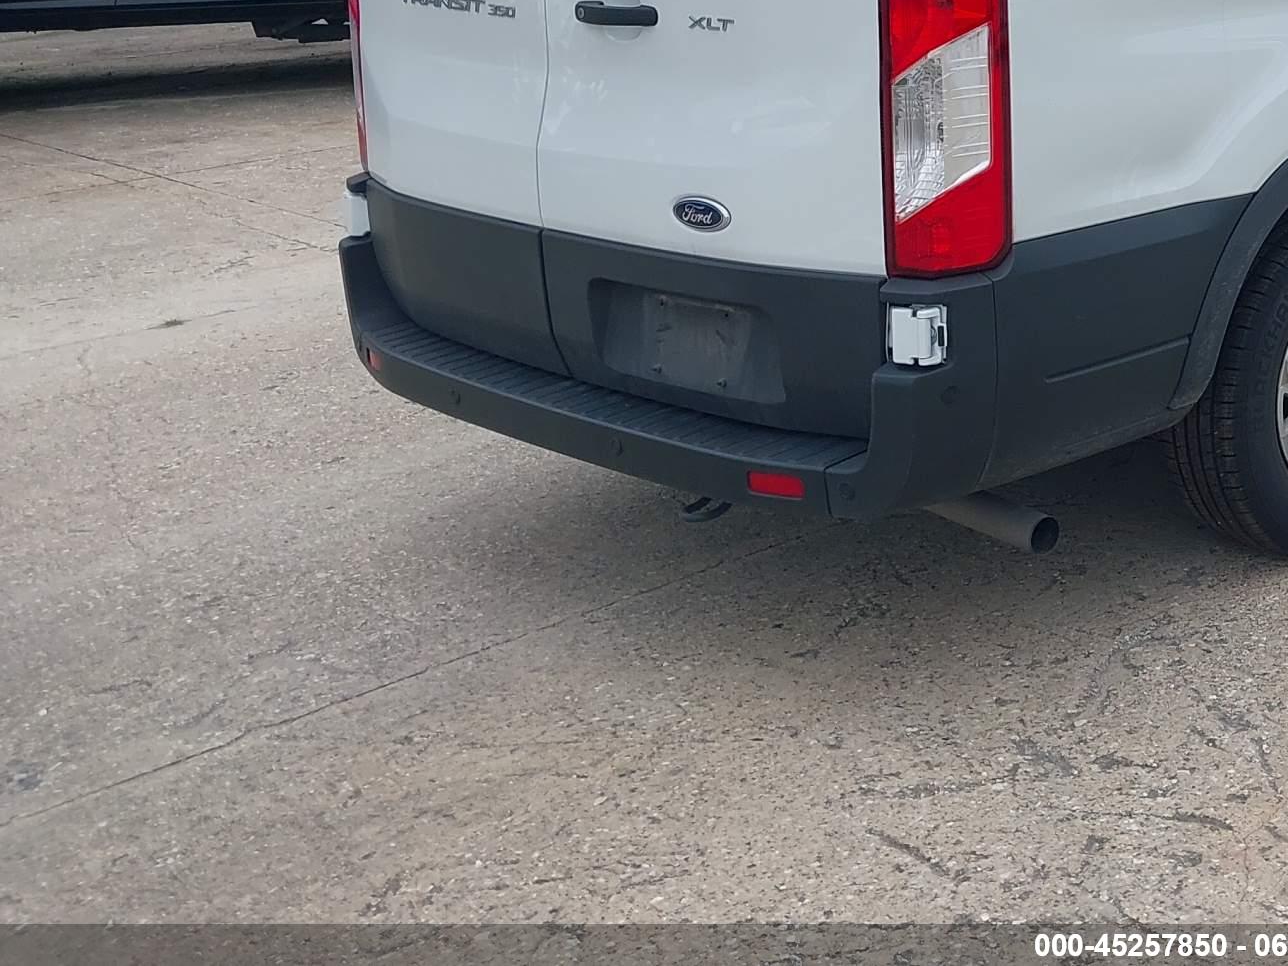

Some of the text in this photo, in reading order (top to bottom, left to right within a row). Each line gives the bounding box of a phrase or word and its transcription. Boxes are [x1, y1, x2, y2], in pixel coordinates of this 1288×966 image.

[487, 3, 516, 18] 350
[688, 16, 735, 32] XLT
[682, 203, 713, 225] Ford
